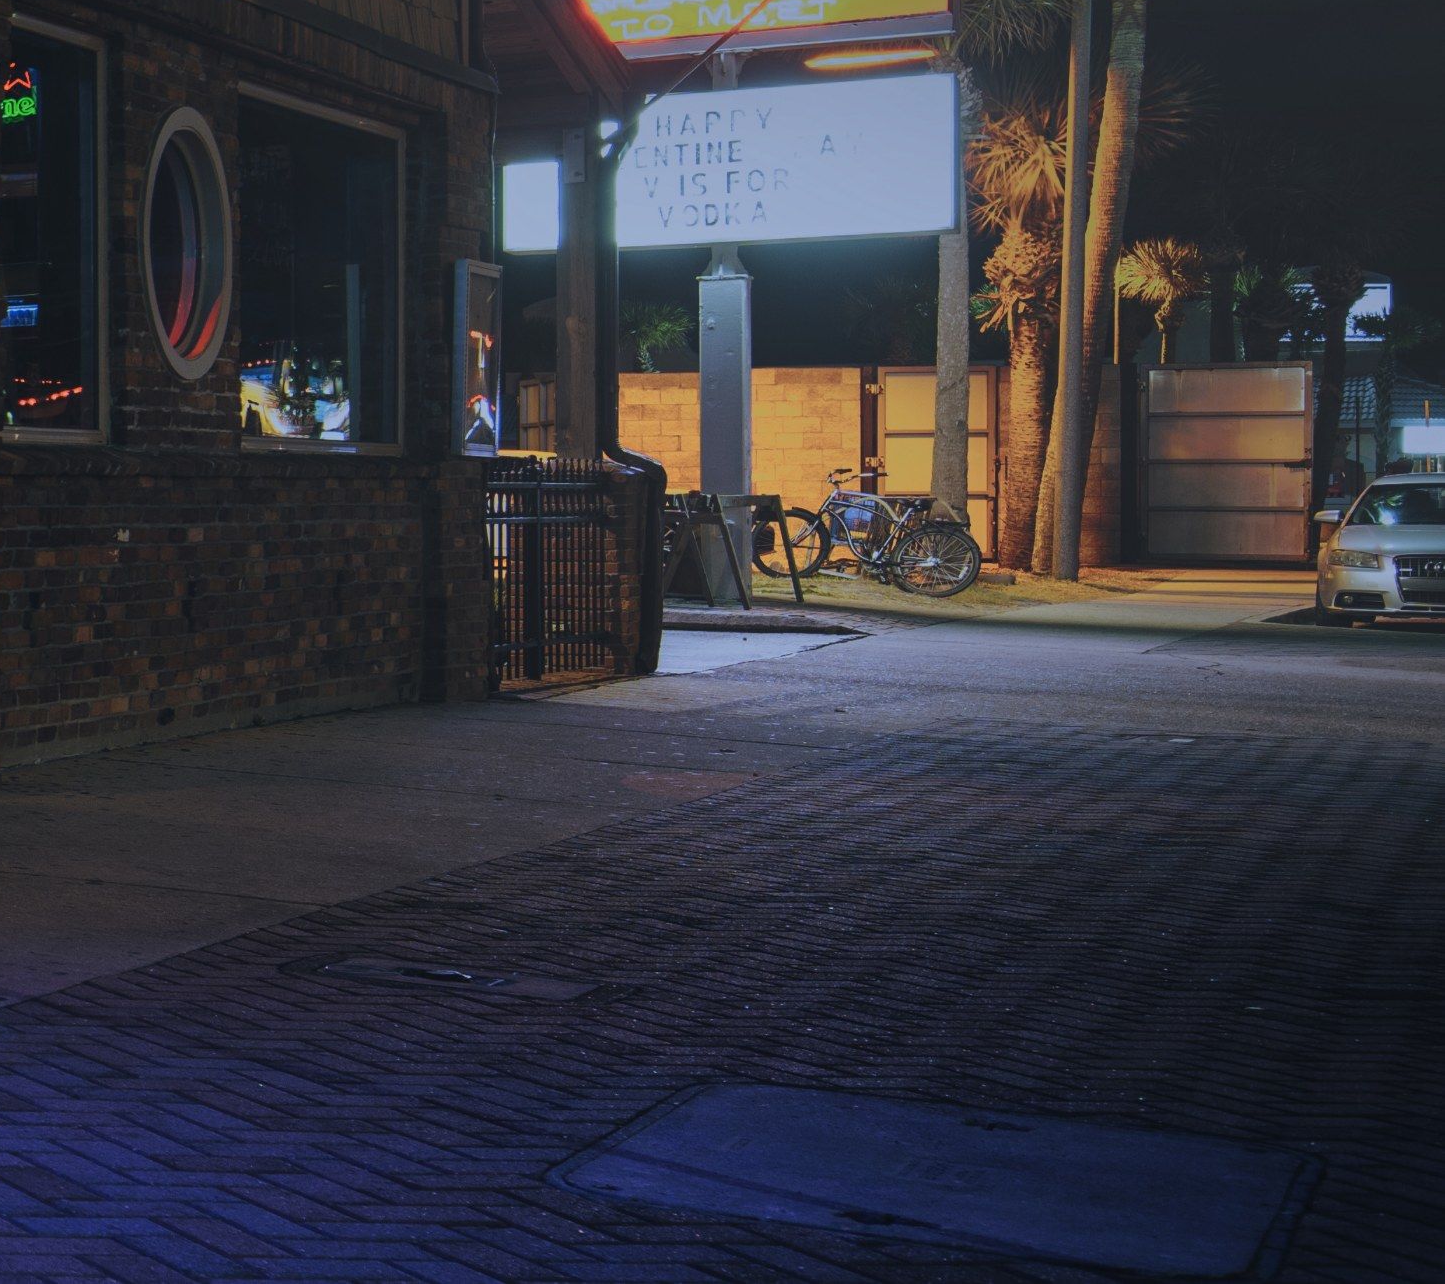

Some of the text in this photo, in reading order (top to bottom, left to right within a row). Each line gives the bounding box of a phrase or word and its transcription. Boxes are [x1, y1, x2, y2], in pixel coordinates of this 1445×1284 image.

[610, 13, 674, 40] TO
[656, 107, 773, 137] HAPPY
[634, 139, 743, 169] ENTINE
[644, 168, 789, 199] V IS FOR
[657, 200, 767, 229] VODKA
